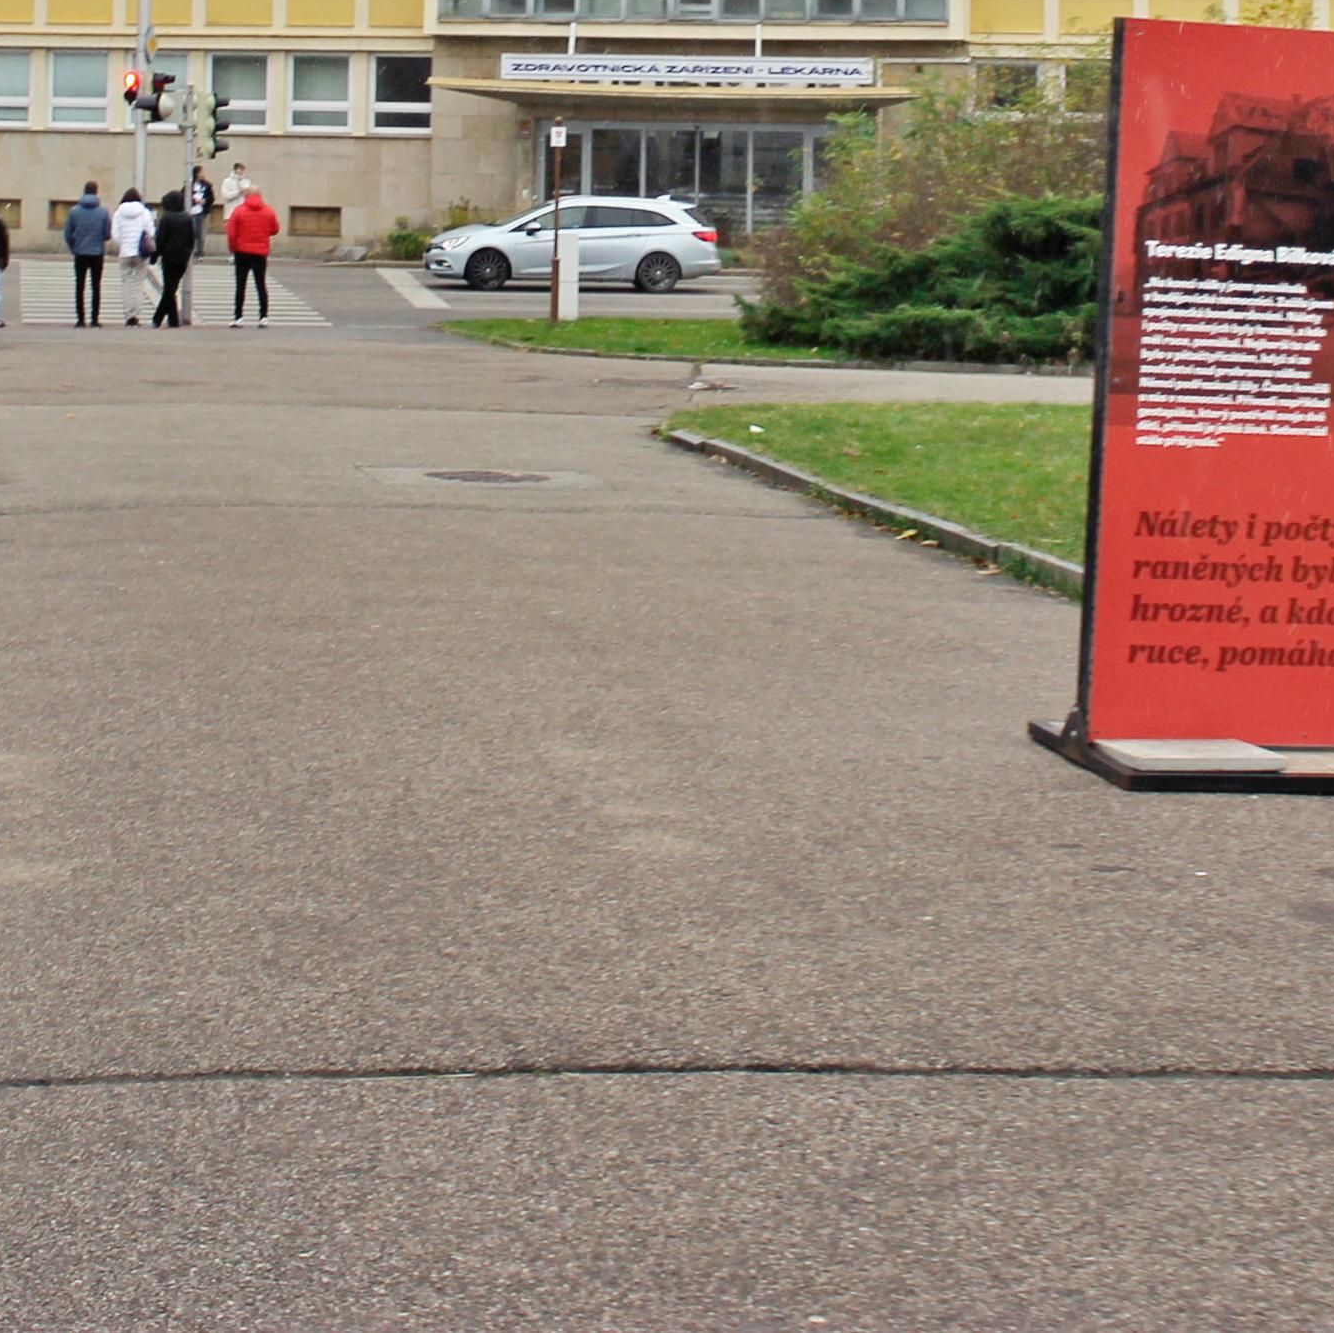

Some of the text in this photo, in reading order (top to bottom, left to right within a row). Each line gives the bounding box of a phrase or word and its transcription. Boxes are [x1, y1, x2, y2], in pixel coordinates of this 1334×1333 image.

[511, 62, 661, 74] ZDRAVOTNICKÁ
[666, 64, 755, 75] ZAŘÍZENÍ
[767, 65, 863, 76] LÉKÁRNA
[1144, 239, 1214, 260] Terezie
[1134, 510, 1240, 546] Nálety
[1245, 513, 1258, 540] i
[1132, 553, 1284, 588] raněných
[1130, 594, 1251, 629] hrozné,
[1259, 605, 1279, 625] a
[1127, 643, 1210, 669] ruce,
